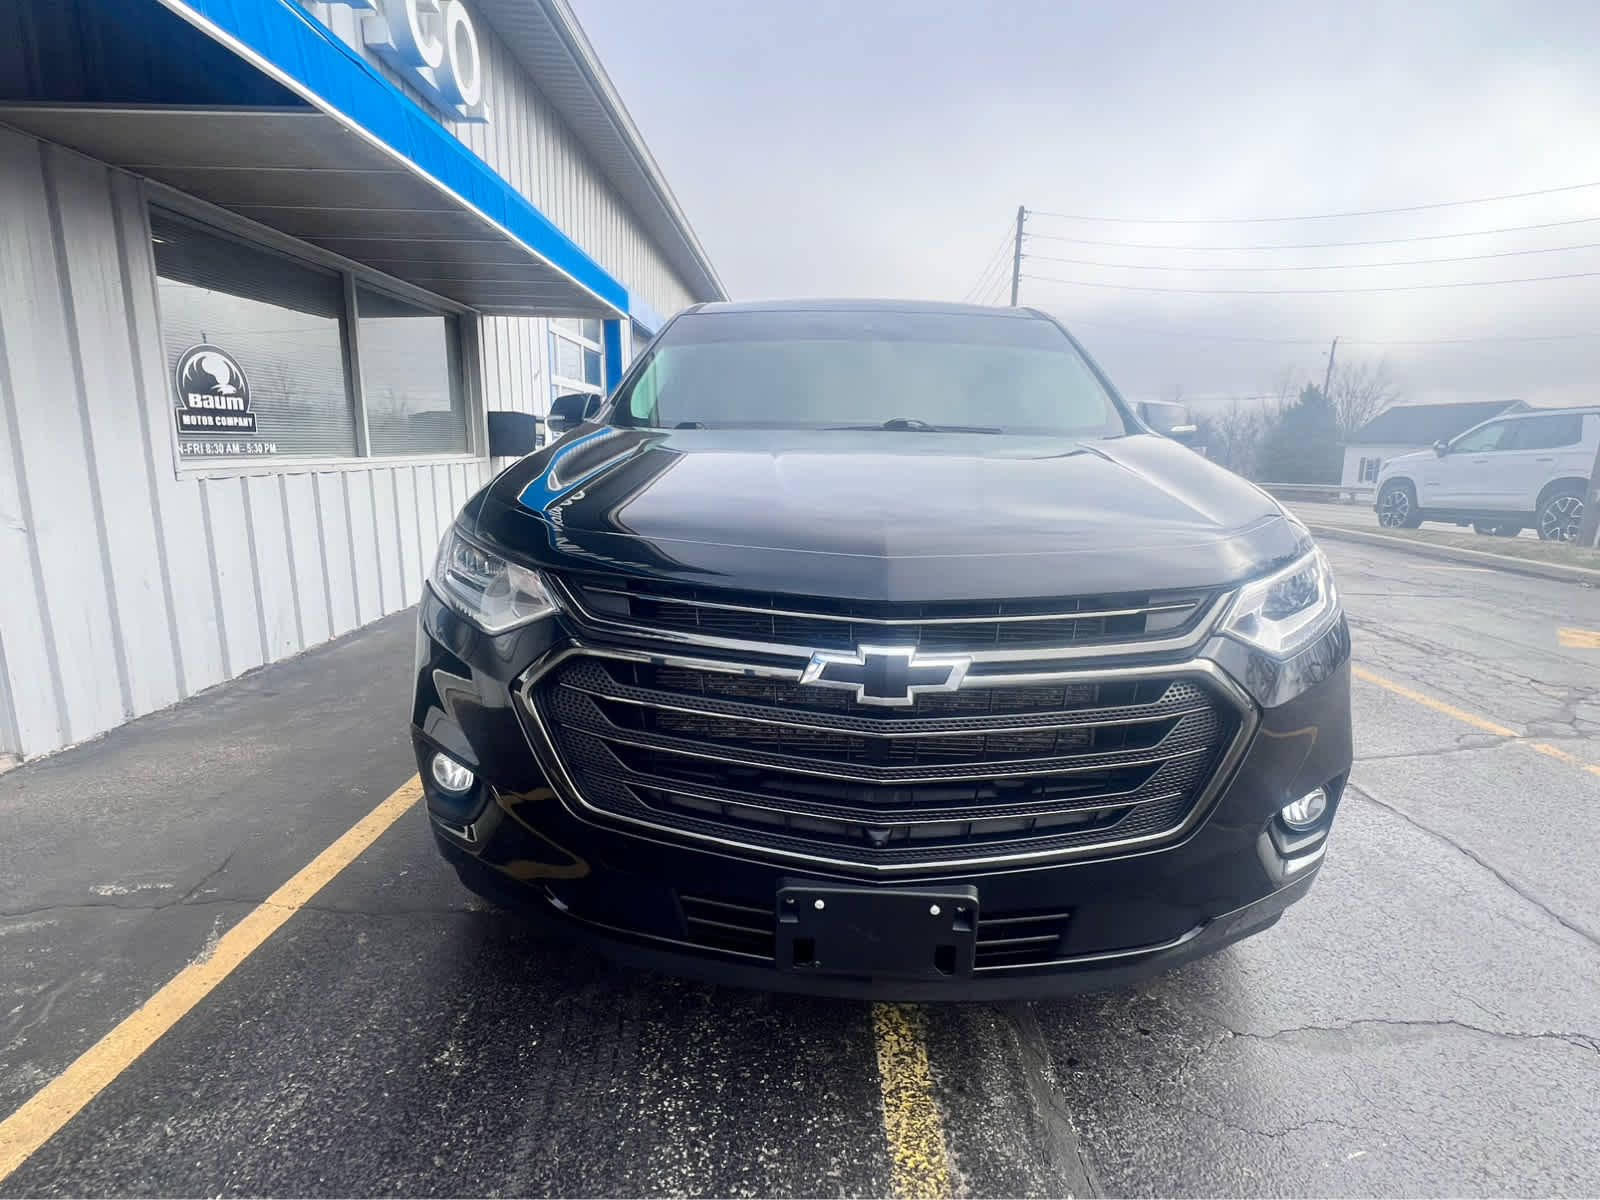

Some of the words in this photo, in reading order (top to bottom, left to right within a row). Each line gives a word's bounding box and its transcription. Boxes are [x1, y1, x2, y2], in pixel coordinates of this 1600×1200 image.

[188, 393, 244, 411] Baum
[182, 415, 214, 426] MOTOR
[215, 415, 253, 427] COMPANY
[205, 442, 224, 455] 8:30
[225, 442, 240, 455] AM
[247, 442, 263, 455] 5:30
[264, 442, 277, 454] PM
